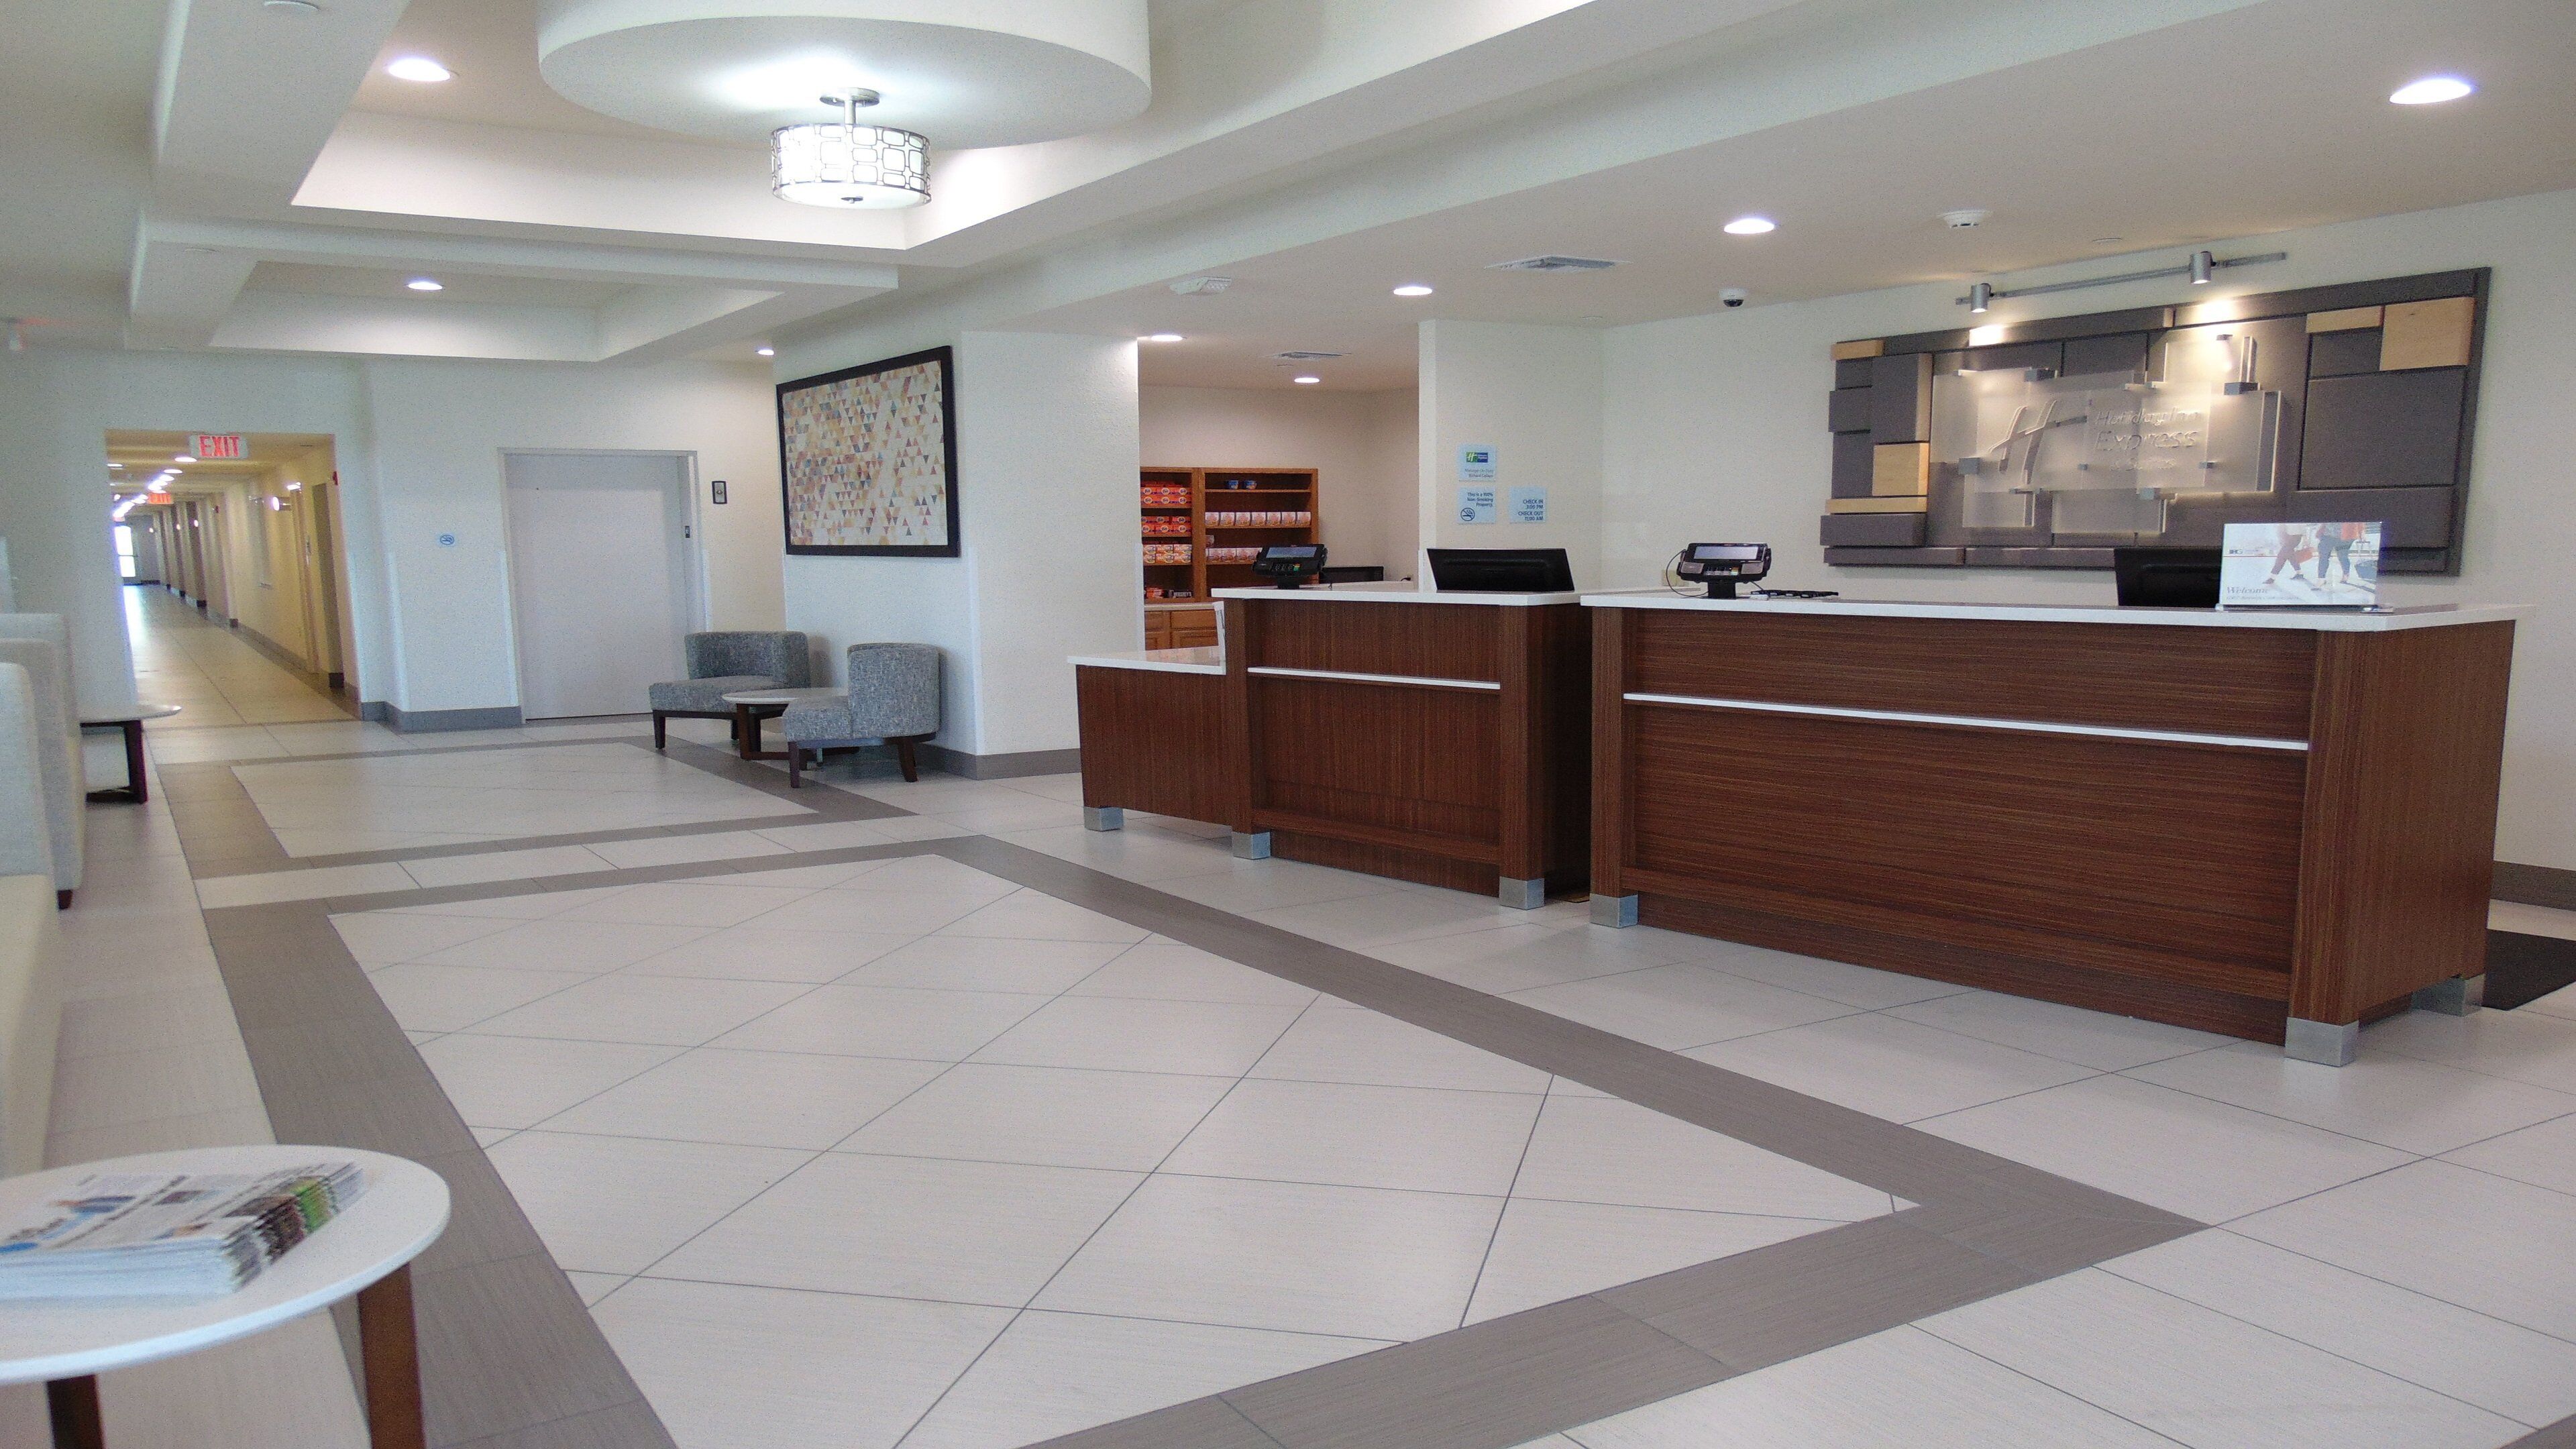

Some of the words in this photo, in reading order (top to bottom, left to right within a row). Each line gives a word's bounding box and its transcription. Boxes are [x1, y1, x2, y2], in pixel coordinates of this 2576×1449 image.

[2095, 408, 2168, 426] Holiday
[199, 435, 240, 457] EXIT
[2095, 430, 2200, 453] Express
